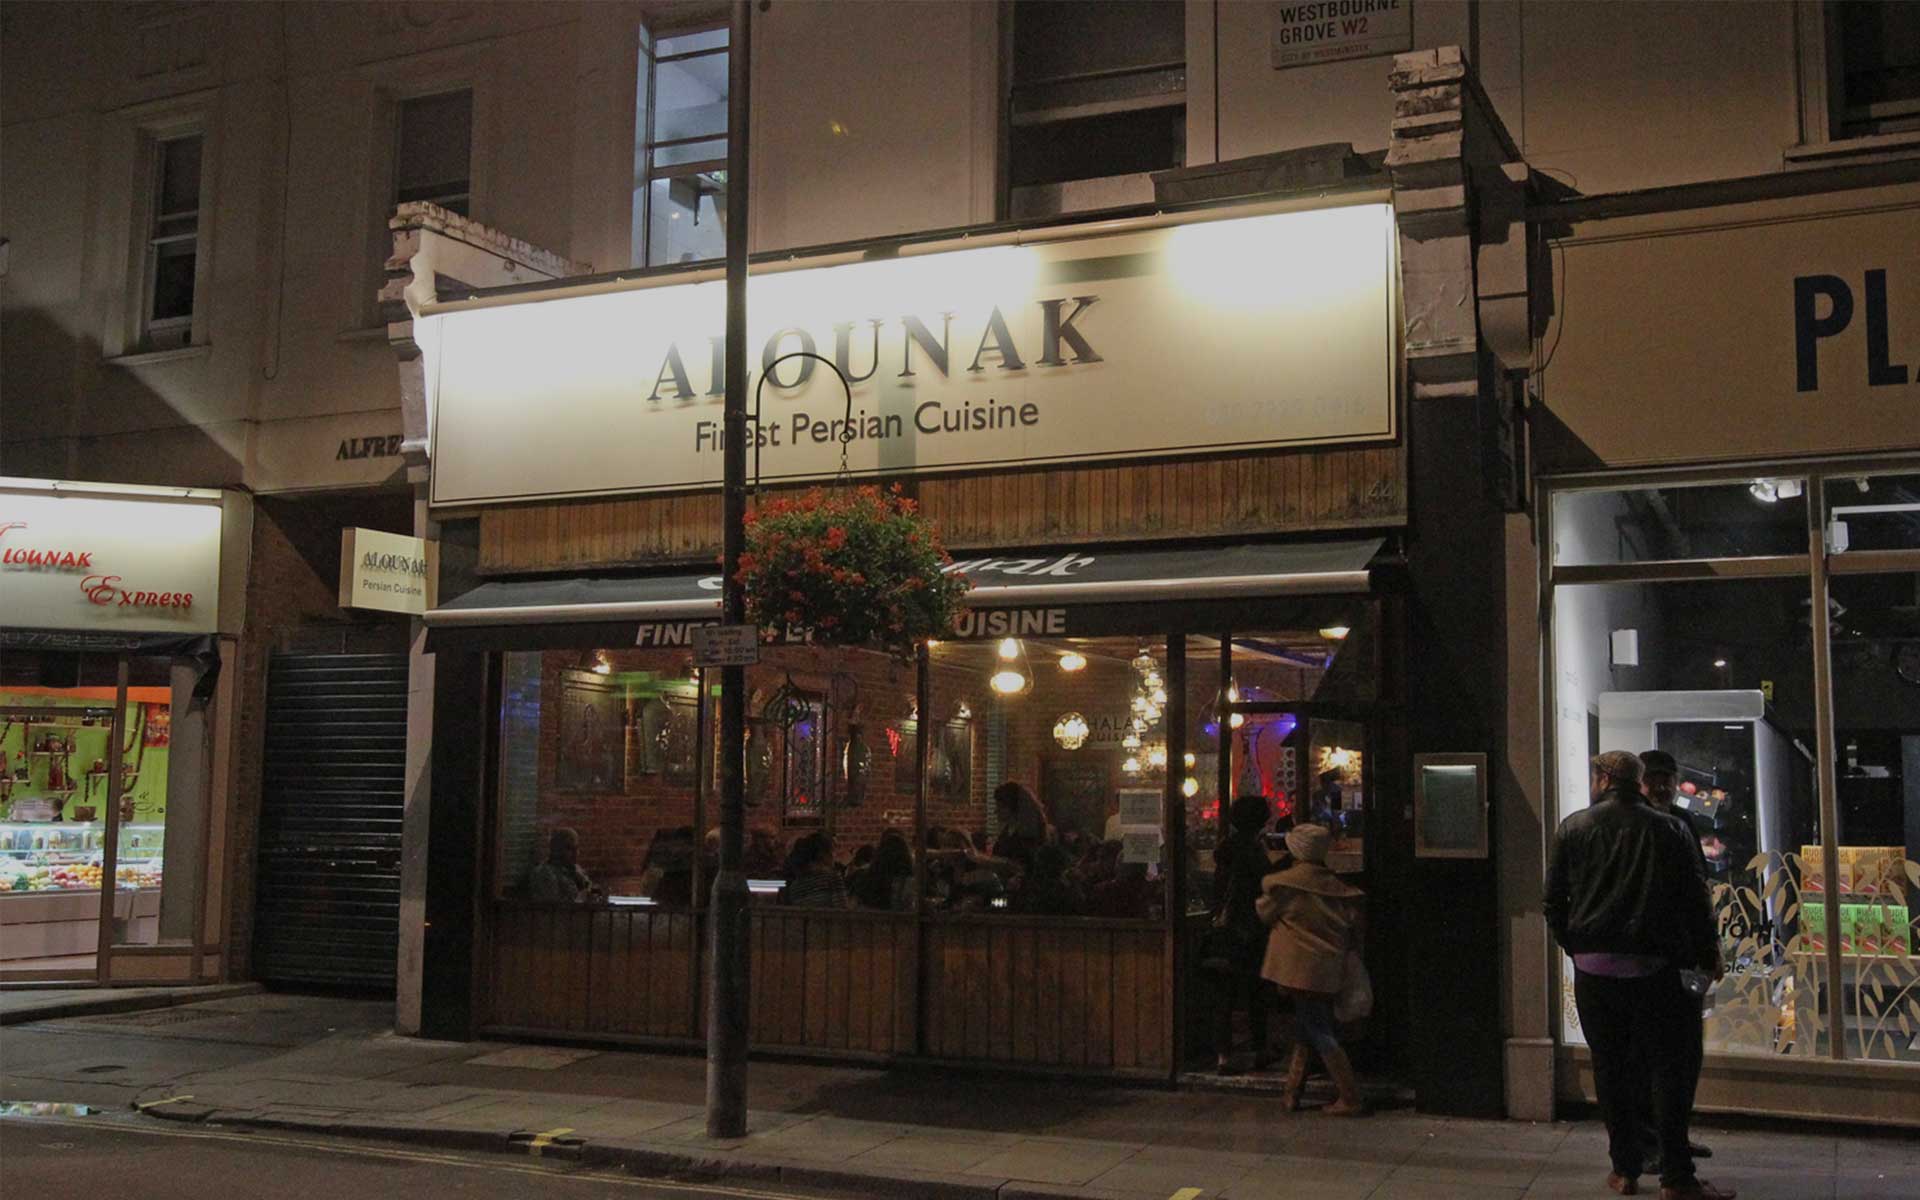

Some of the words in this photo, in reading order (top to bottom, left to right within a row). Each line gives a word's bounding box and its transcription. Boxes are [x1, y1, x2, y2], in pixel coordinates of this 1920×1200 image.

[1280, 0, 1399, 24] WESTBOURNE
[1280, 22, 1336, 44] GROVE
[1342, 17, 1368, 35] W2
[1794, 269, 1920, 393] PL
[646, 295, 1104, 401] ALOUNAK
[792, 411, 902, 445] Persian
[915, 399, 1039, 433] Cuisine
[955, 608, 1067, 638] UISINE
[1087, 716, 1134, 731] HALA
